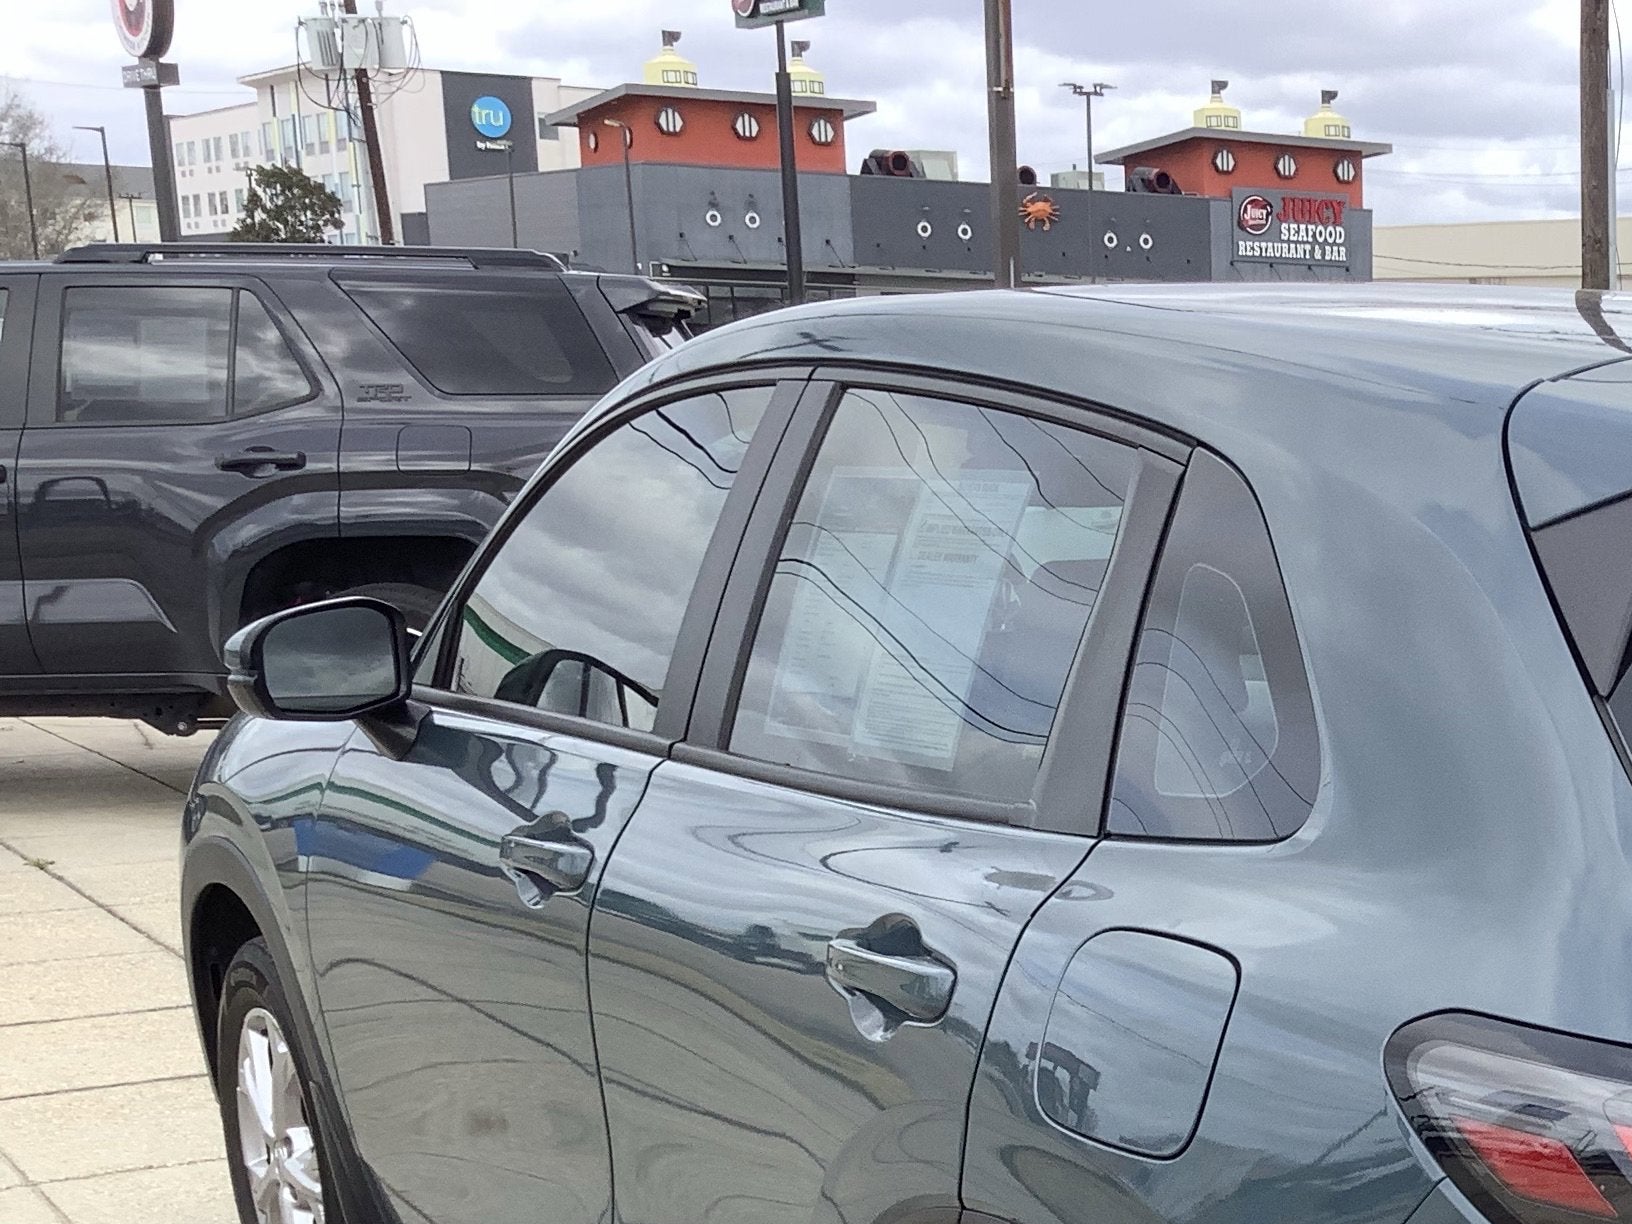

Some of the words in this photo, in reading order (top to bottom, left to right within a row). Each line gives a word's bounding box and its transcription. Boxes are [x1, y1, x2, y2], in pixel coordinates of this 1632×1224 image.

[471, 104, 504, 127] tru
[1243, 204, 1268, 220] JUICY
[1276, 197, 1345, 226] JUICY
[1280, 223, 1345, 244] SEAFOOD
[1238, 241, 1311, 259] RESTAURANT
[1313, 244, 1322, 260] &
[1324, 246, 1347, 261] BAR
[359, 383, 404, 395] TRD
